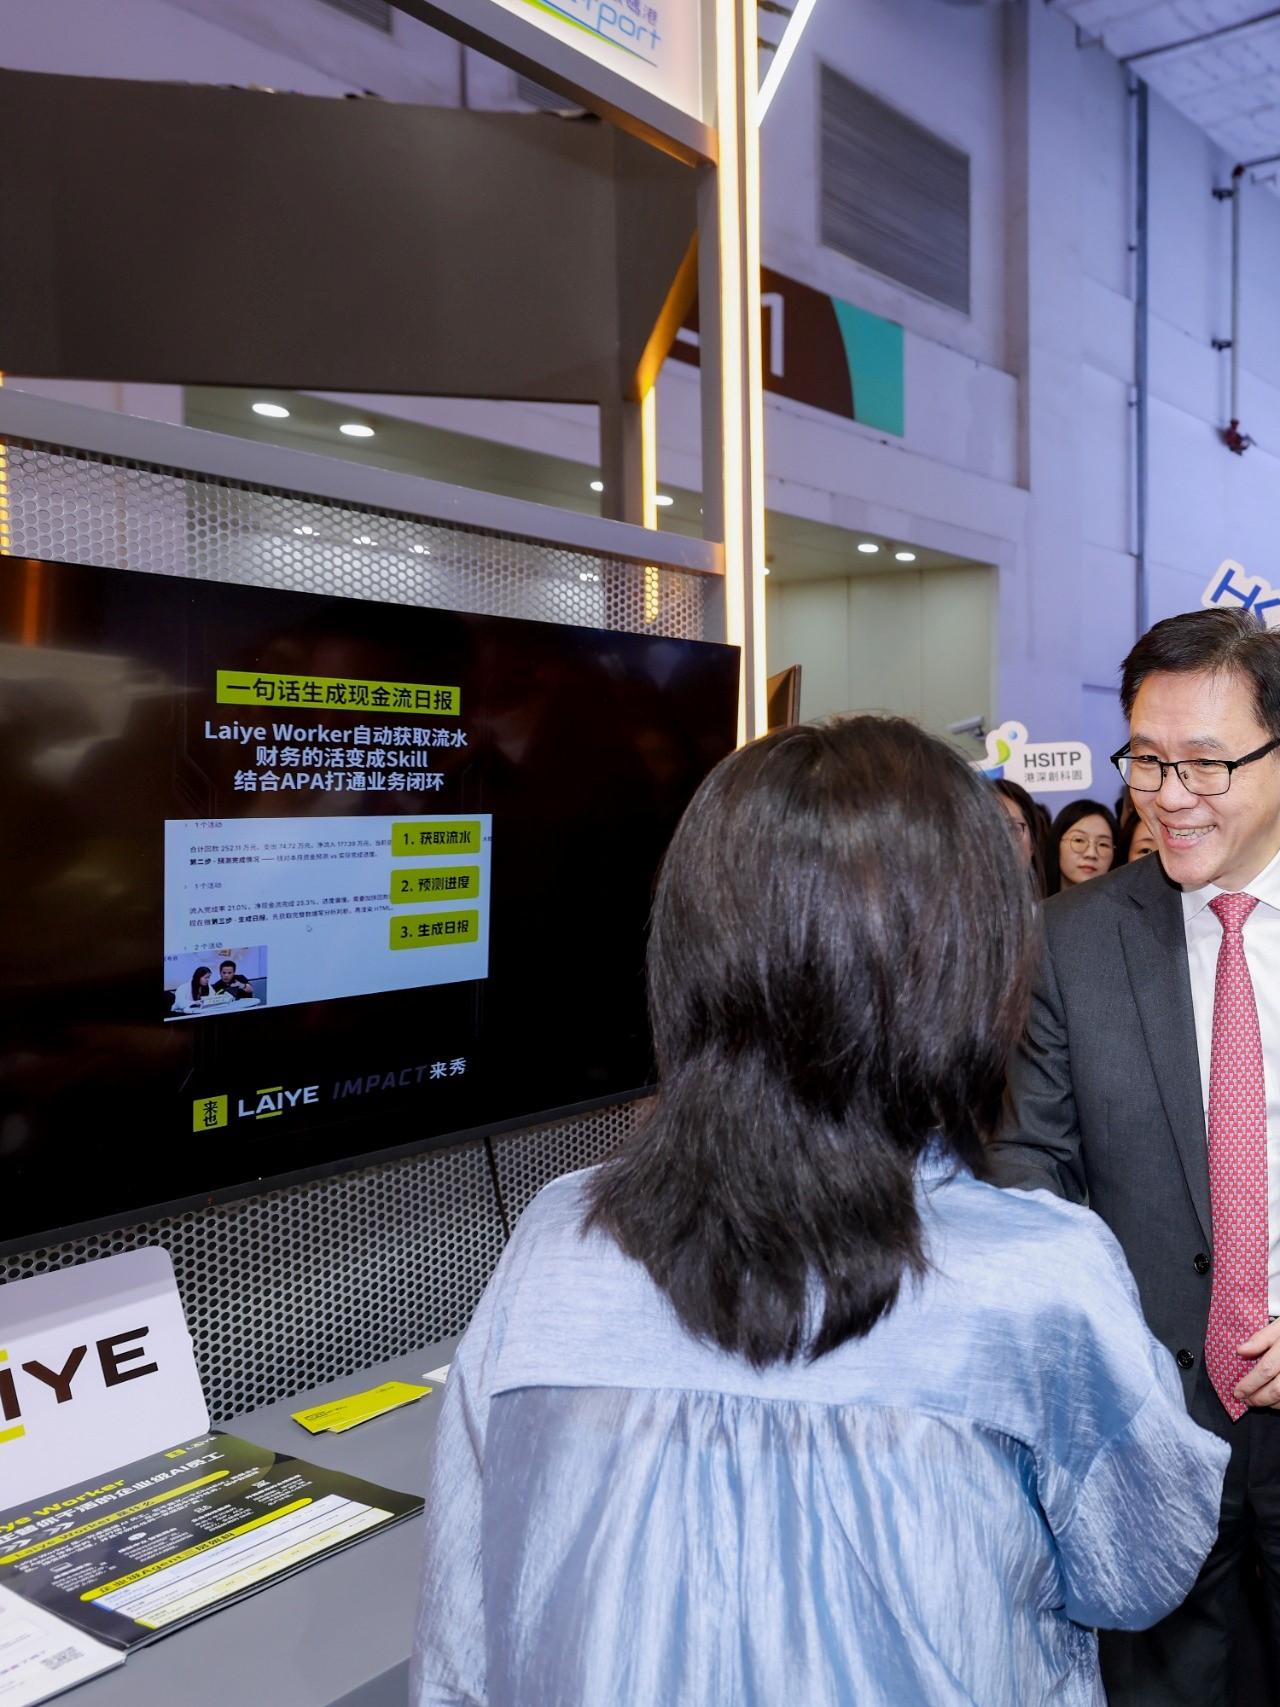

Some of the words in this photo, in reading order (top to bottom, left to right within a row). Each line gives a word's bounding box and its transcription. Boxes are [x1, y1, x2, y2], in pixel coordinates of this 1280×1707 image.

[227, 679, 452, 711] 一句话生成现金流日报
[204, 721, 267, 744] Laiye
[272, 724, 468, 748] Worker自动获取流水
[256, 746, 428, 768] 财务的活变成Skill
[1023, 751, 1081, 768] HSITP
[234, 770, 445, 791] 结合APA打通业务闭环
[403, 833, 414, 846] 1.
[420, 831, 471, 845] 获取流水
[401, 880, 413, 892] 2.
[418, 876, 470, 892] 预测进度
[400, 926, 413, 938] 3.
[418, 920, 469, 937] 生成日报
[238, 1085, 319, 1118] LAIYE
[429, 1057, 467, 1080] 来秀
[33, 1479, 125, 1516] Worker
